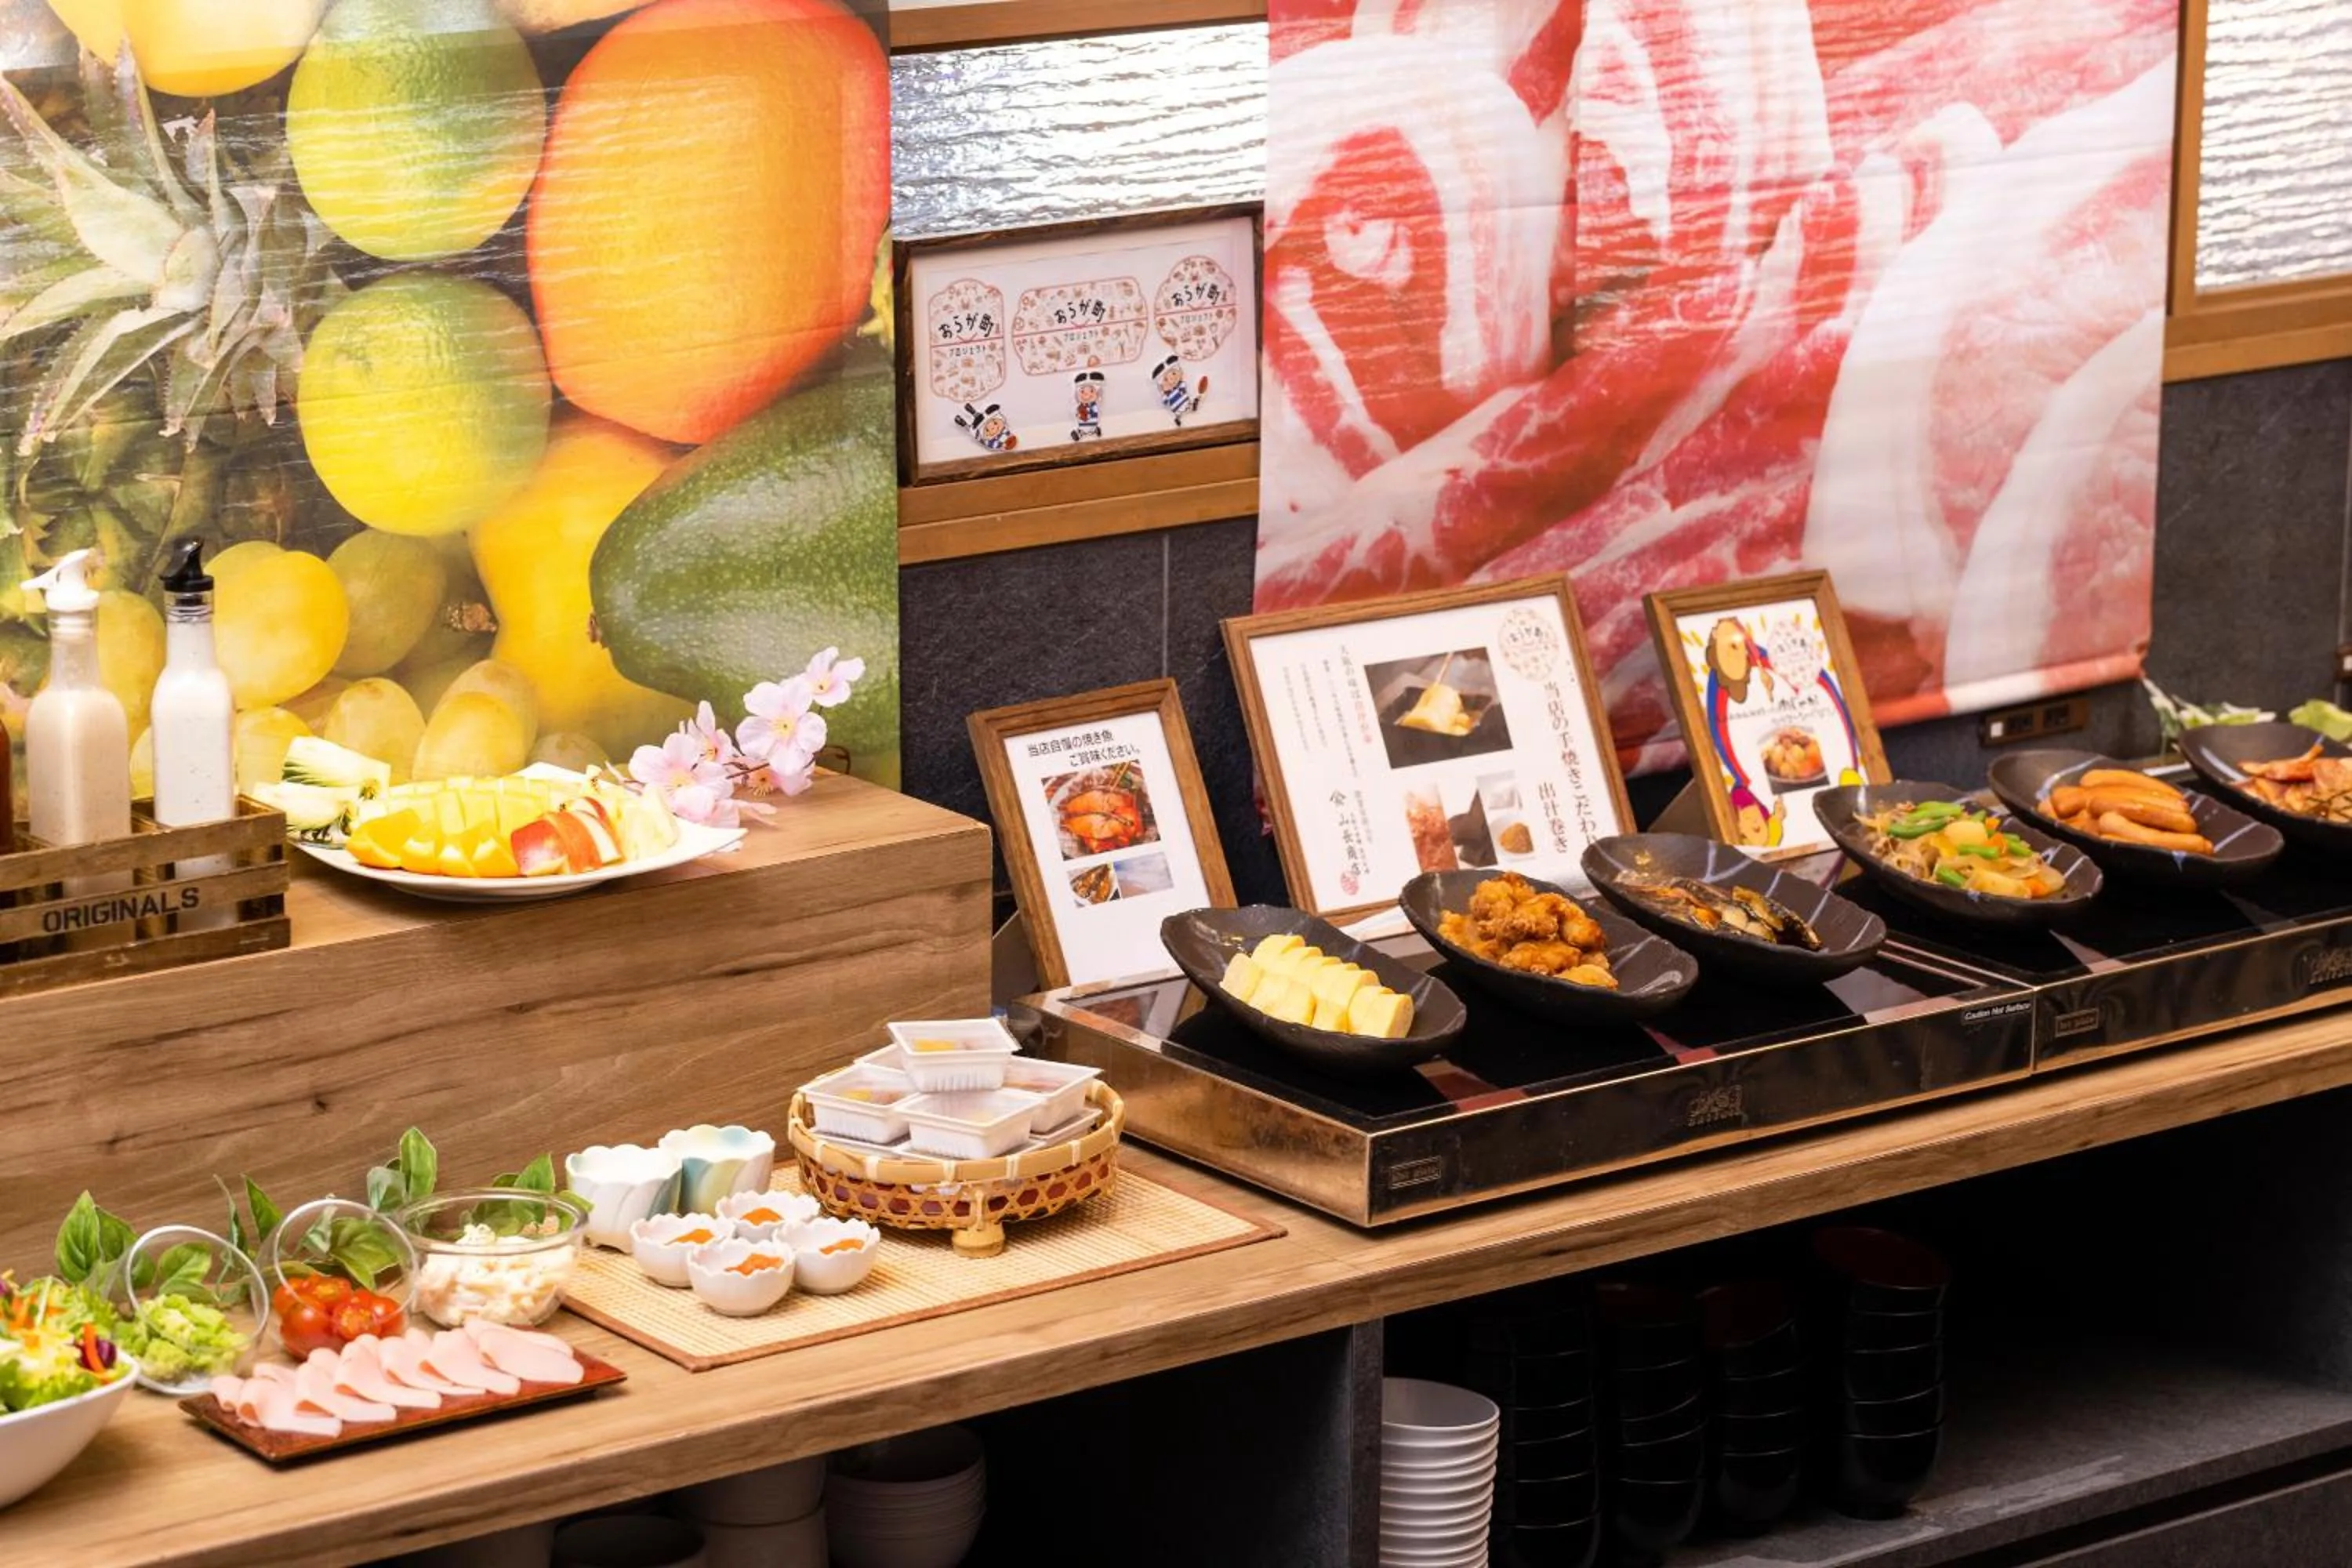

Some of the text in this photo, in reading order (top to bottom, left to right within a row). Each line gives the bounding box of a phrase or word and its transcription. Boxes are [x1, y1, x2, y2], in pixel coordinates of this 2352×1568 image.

[938, 312, 995, 339] おらが町
[1054, 299, 1106, 325] おらが町
[42, 887, 200, 933] ORIGINALS
